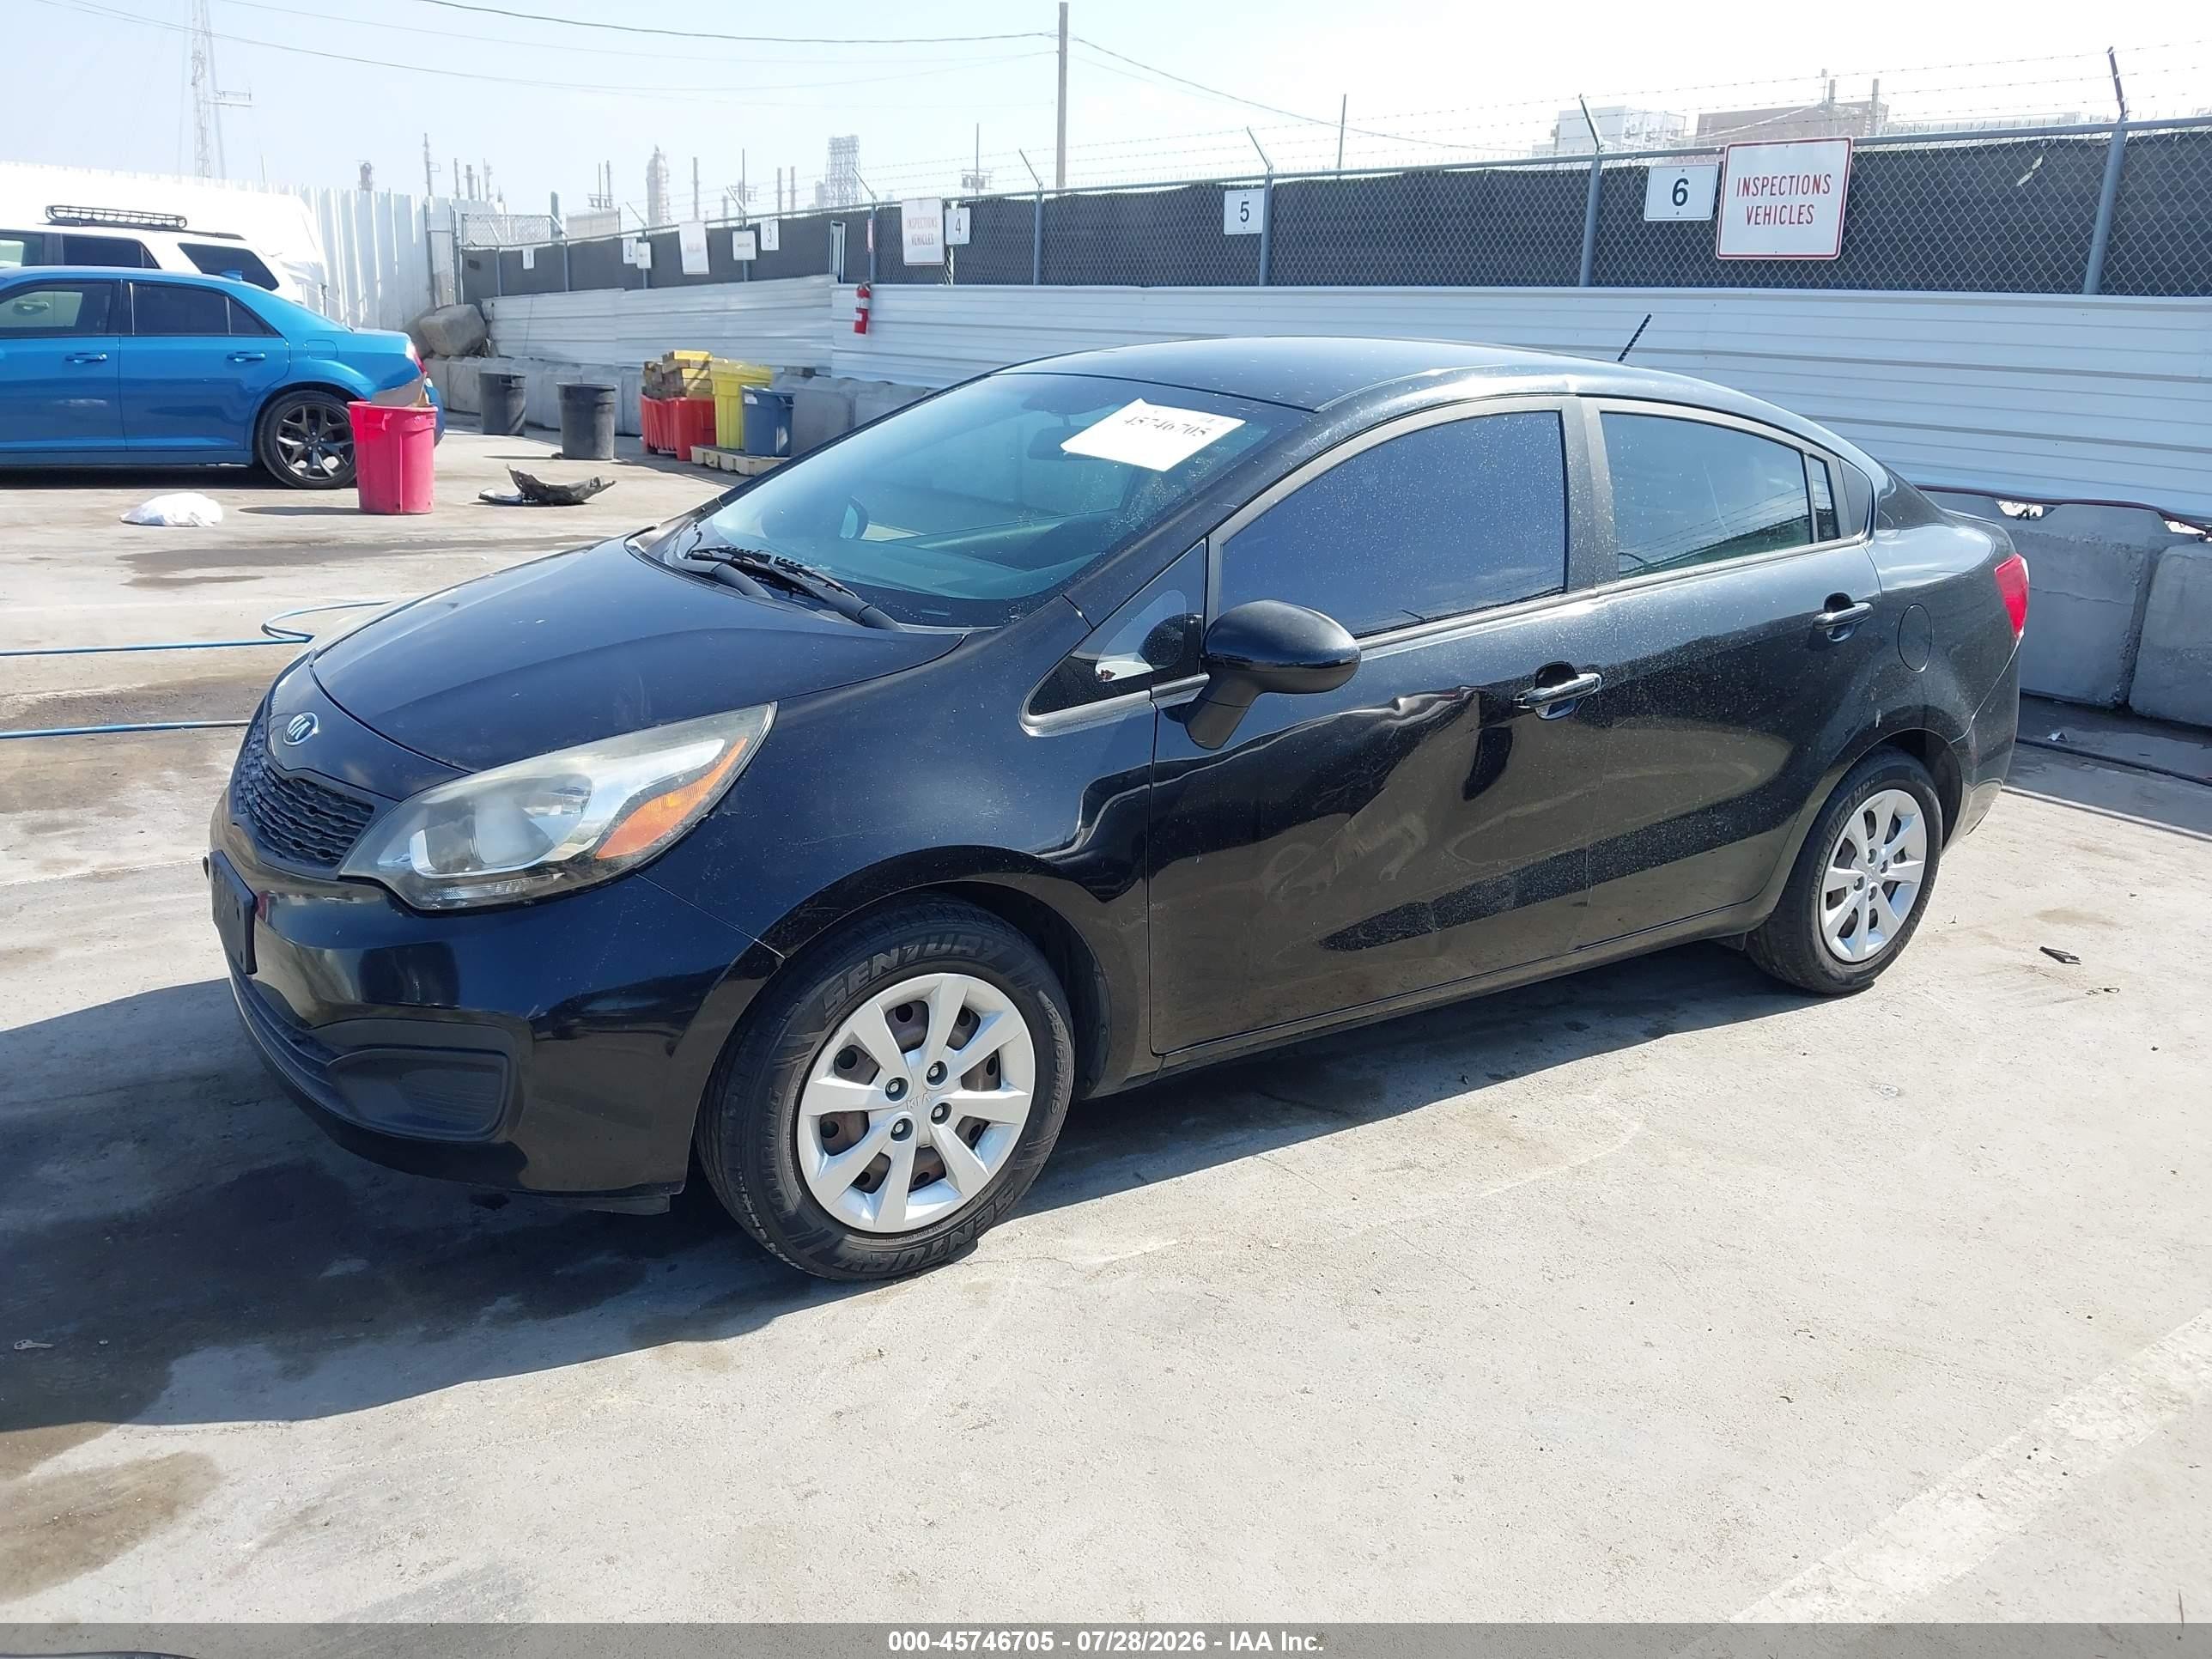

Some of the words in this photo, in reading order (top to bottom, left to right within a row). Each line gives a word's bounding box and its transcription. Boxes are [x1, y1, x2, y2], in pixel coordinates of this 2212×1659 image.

[1671, 177, 1690, 207] 6
[1735, 173, 1832, 198] INSPECTIONS
[1239, 201, 1250, 223] 5
[1746, 204, 1814, 225] VEHICLES
[906, 216, 939, 229] INSPECTIONS
[954, 216, 963, 236] 4
[910, 233, 934, 246] VEHICLES
[906, 1092, 930, 1112] KIA
